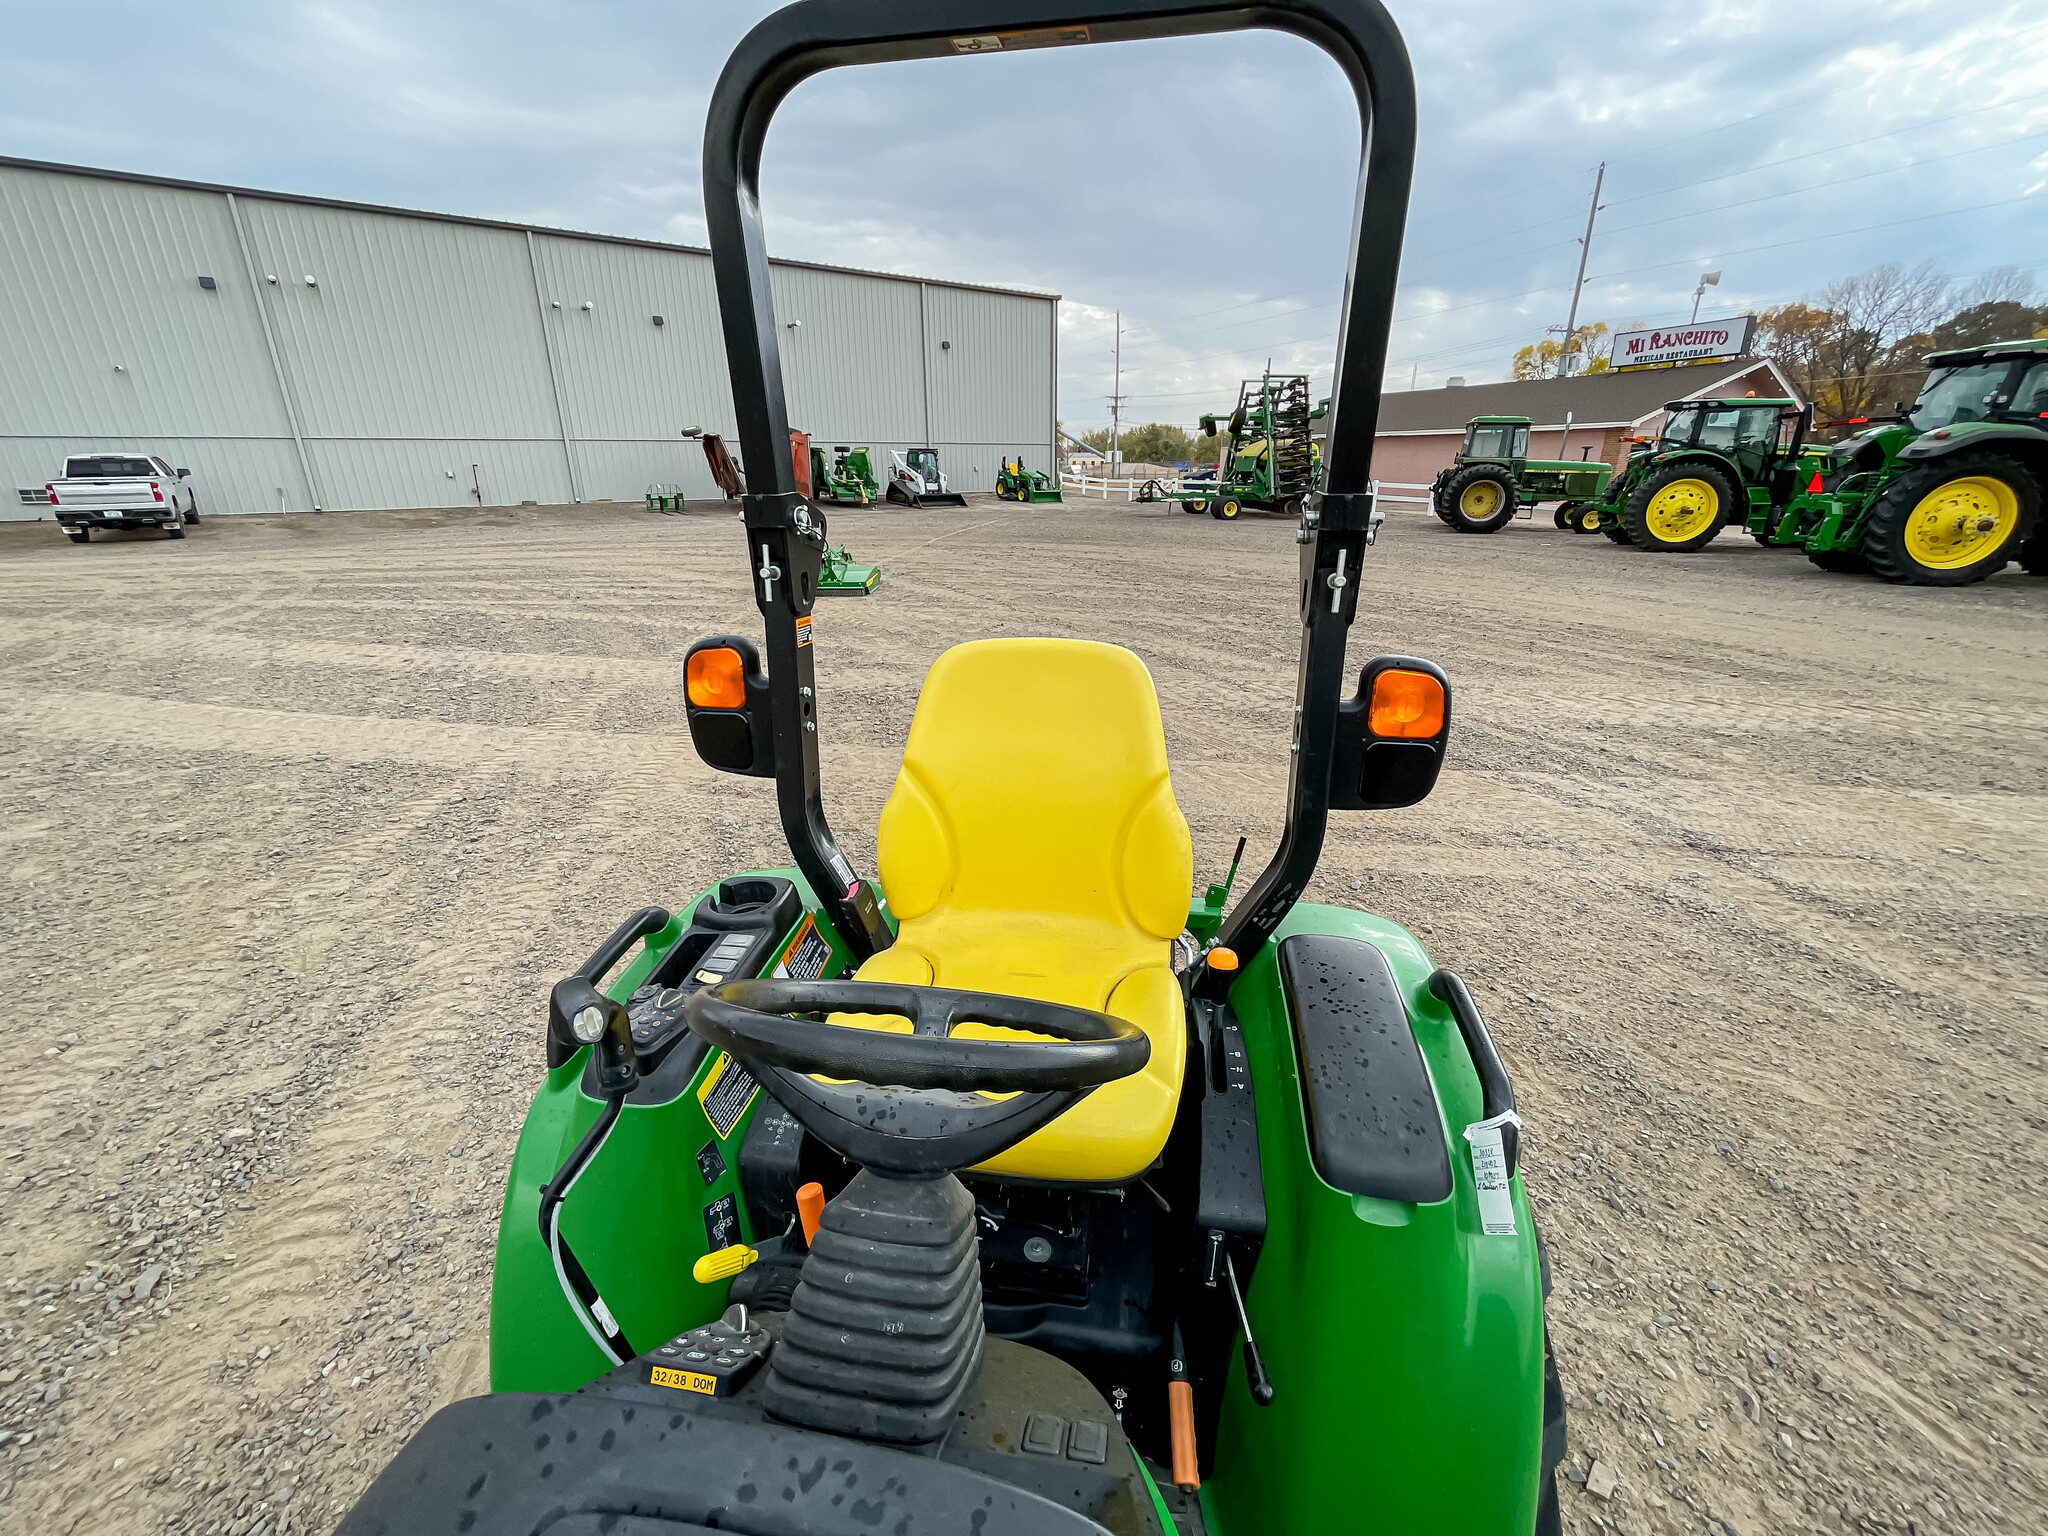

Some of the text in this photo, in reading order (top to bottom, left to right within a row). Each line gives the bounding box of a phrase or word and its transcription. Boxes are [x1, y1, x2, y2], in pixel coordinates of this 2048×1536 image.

[1634, 347, 1713, 363] MEXICAN RESTAURANT
[654, 1370, 714, 1391] 32/38 DOM
